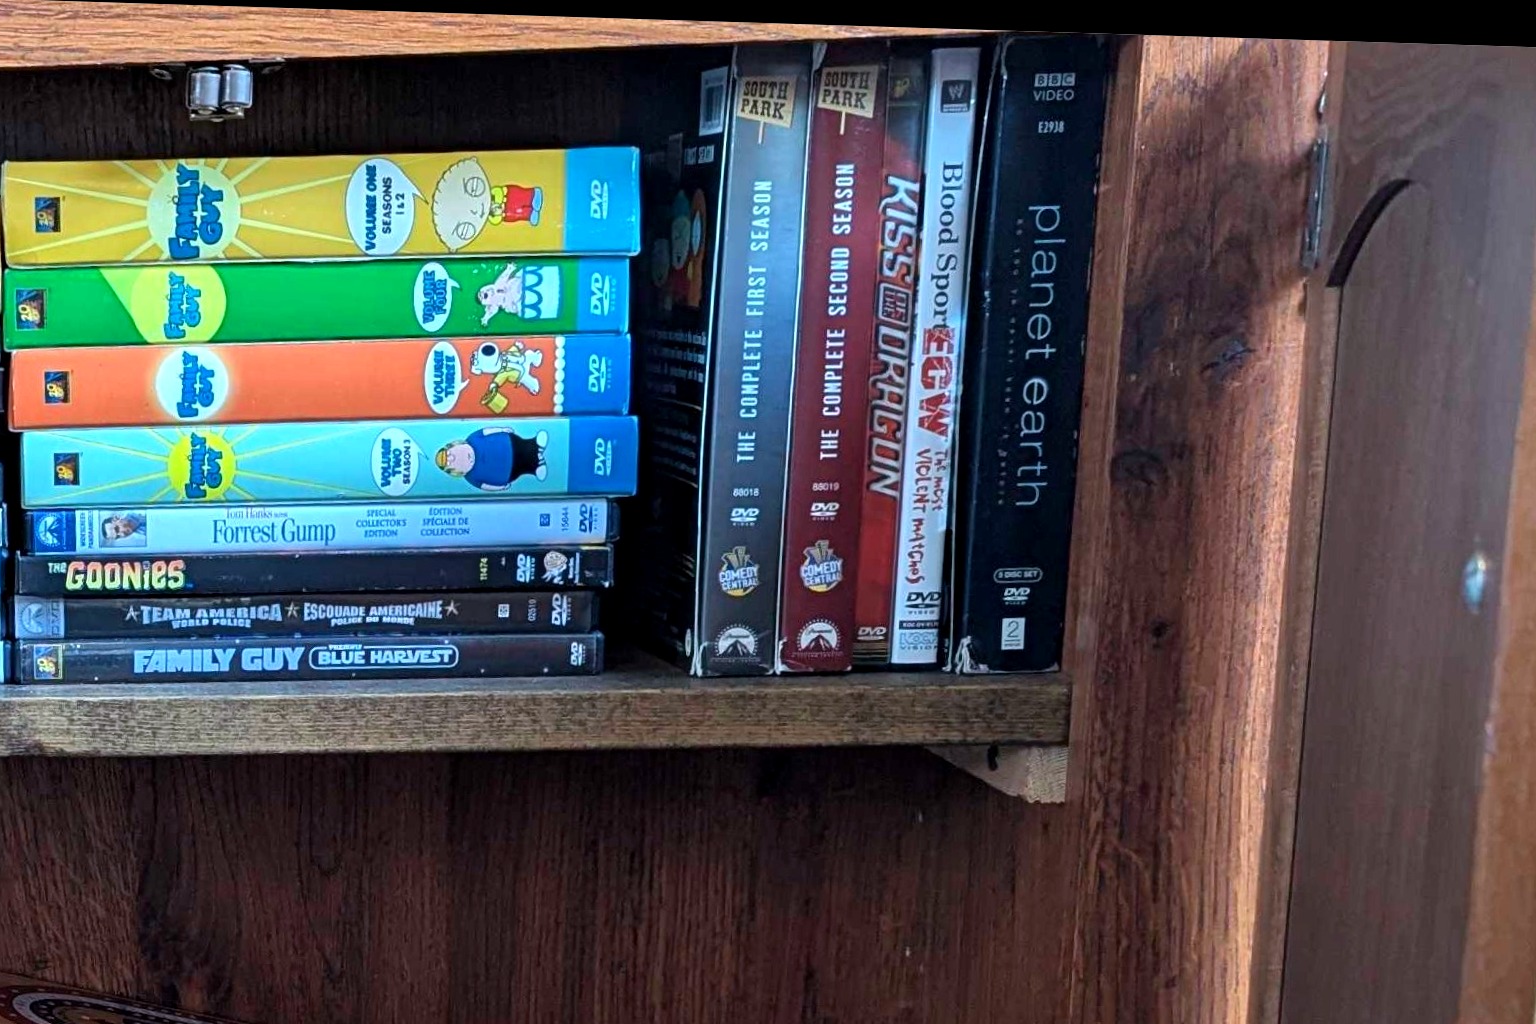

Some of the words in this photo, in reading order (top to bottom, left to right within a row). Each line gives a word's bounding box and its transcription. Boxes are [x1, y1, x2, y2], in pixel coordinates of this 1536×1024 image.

[743, 81, 789, 99] SOUTH
[822, 89, 867, 109] PARK
[824, 71, 871, 89] SOUTH
[1033, 89, 1075, 101] VIDEO
[740, 99, 785, 120] PARK
[366, 164, 377, 195] ONE
[381, 176, 393, 235] SEASONS
[833, 163, 855, 235] SEASON
[939, 161, 964, 245] Blood
[168, 163, 200, 260] FAMILY
[199, 182, 223, 245] GUY
[365, 197, 377, 251] VOLUME
[750, 180, 771, 252] SEASON
[879, 175, 919, 285] KISS
[185, 284, 202, 327] GUY
[422, 270, 436, 324] VOLUME
[434, 279, 448, 315] FOUR
[745, 266, 767, 318] FIRST
[828, 247, 850, 316] SECOND
[930, 253, 958, 331] Sport
[1025, 204, 1066, 360] planet
[433, 350, 444, 405] VOLUME
[739, 327, 763, 419] COMPLETE
[822, 327, 846, 417] COMPLETE
[918, 327, 956, 438] ECW
[866, 324, 912, 498] DRAGON
[381, 438, 392, 488] VOLUME
[736, 431, 755, 462] THE
[819, 429, 840, 460] THE
[1016, 376, 1051, 507] earth
[213, 519, 278, 544] Forrest
[281, 516, 336, 545] Gump
[721, 578, 760, 590] CENTRAL
[140, 605, 192, 625] TEAM
[194, 603, 283, 622] AMERICA
[303, 602, 366, 623] ESCOUADE
[133, 648, 237, 673] FAMILY
[241, 648, 305, 671] GUY
[318, 651, 365, 665] BLUE
[370, 650, 453, 664] HARVEST
